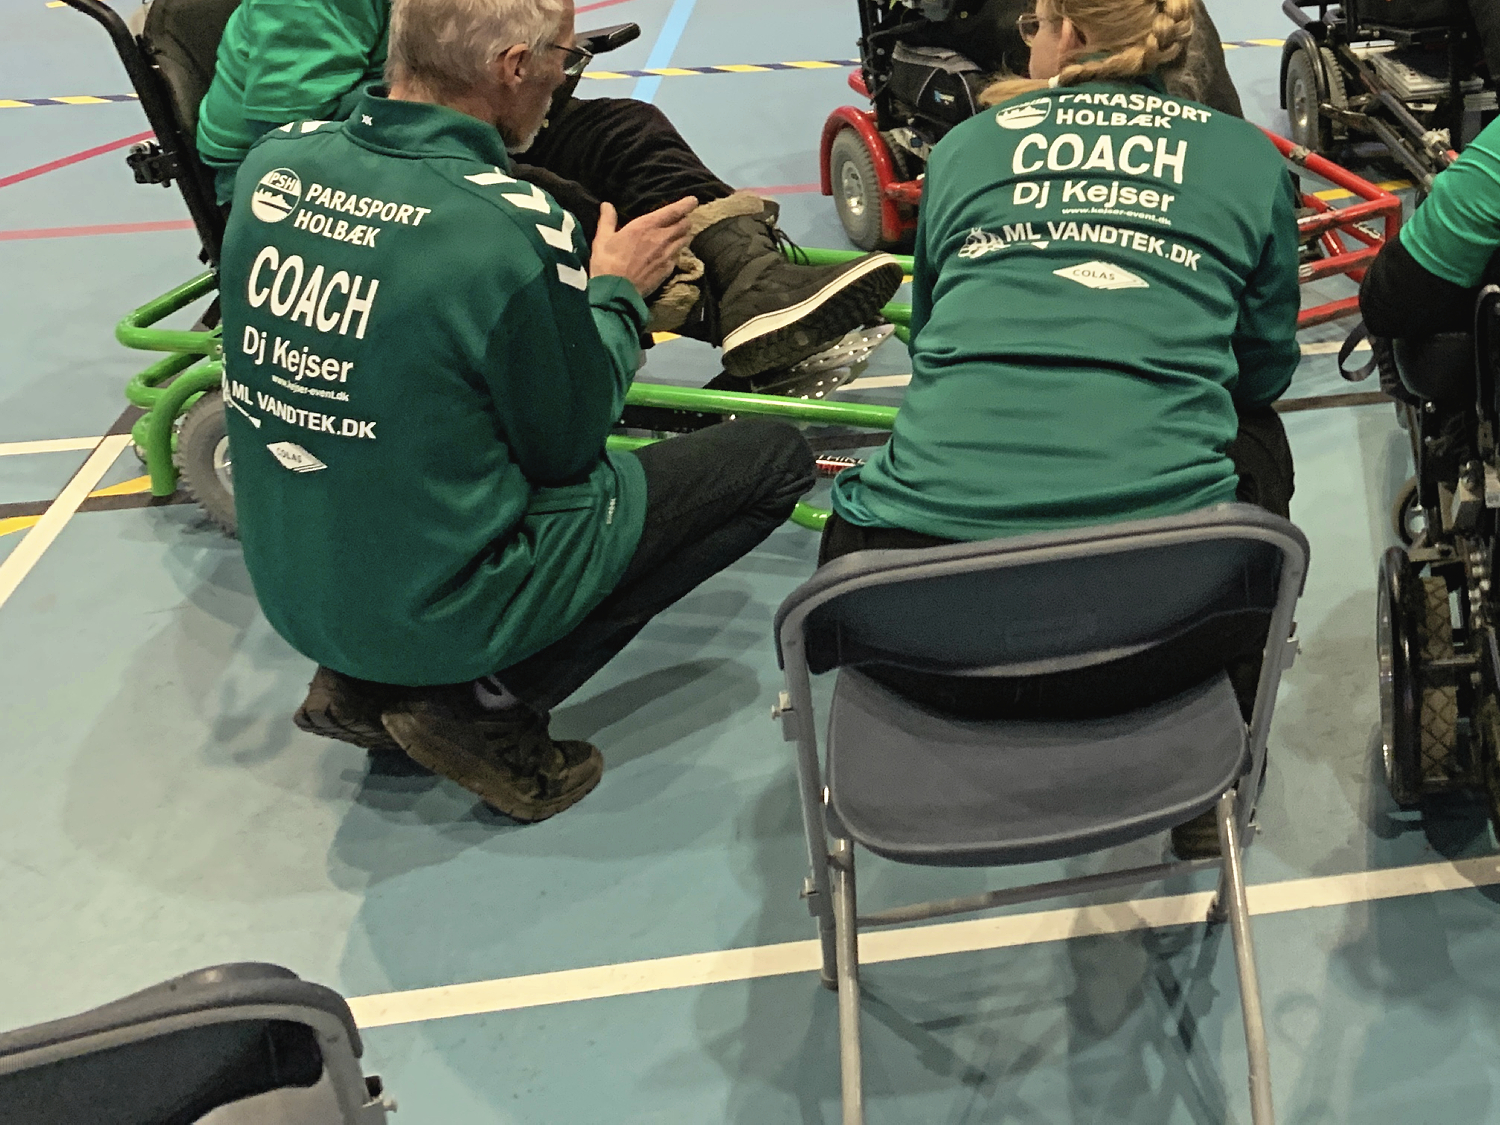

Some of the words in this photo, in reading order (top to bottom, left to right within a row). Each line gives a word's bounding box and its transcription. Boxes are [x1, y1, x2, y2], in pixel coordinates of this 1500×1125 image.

[1056, 108, 1172, 129] HOLBÆK
[1012, 133, 1188, 184] COACH
[269, 172, 297, 191] PSH
[1013, 181, 1051, 209] Dj
[1062, 180, 1175, 212] Kejser
[305, 183, 431, 227] PARASPORT
[294, 210, 381, 248] HOLBÆK
[1003, 222, 1042, 243] ML
[1047, 221, 1202, 272] VANDTEK.DK
[248, 245, 380, 340] COACH
[1072, 268, 1116, 282] COLAS
[242, 325, 267, 365] Dj
[272, 336, 354, 383] Kejser
[232, 380, 254, 406] ML
[257, 391, 377, 440] VANDTEK.DK
